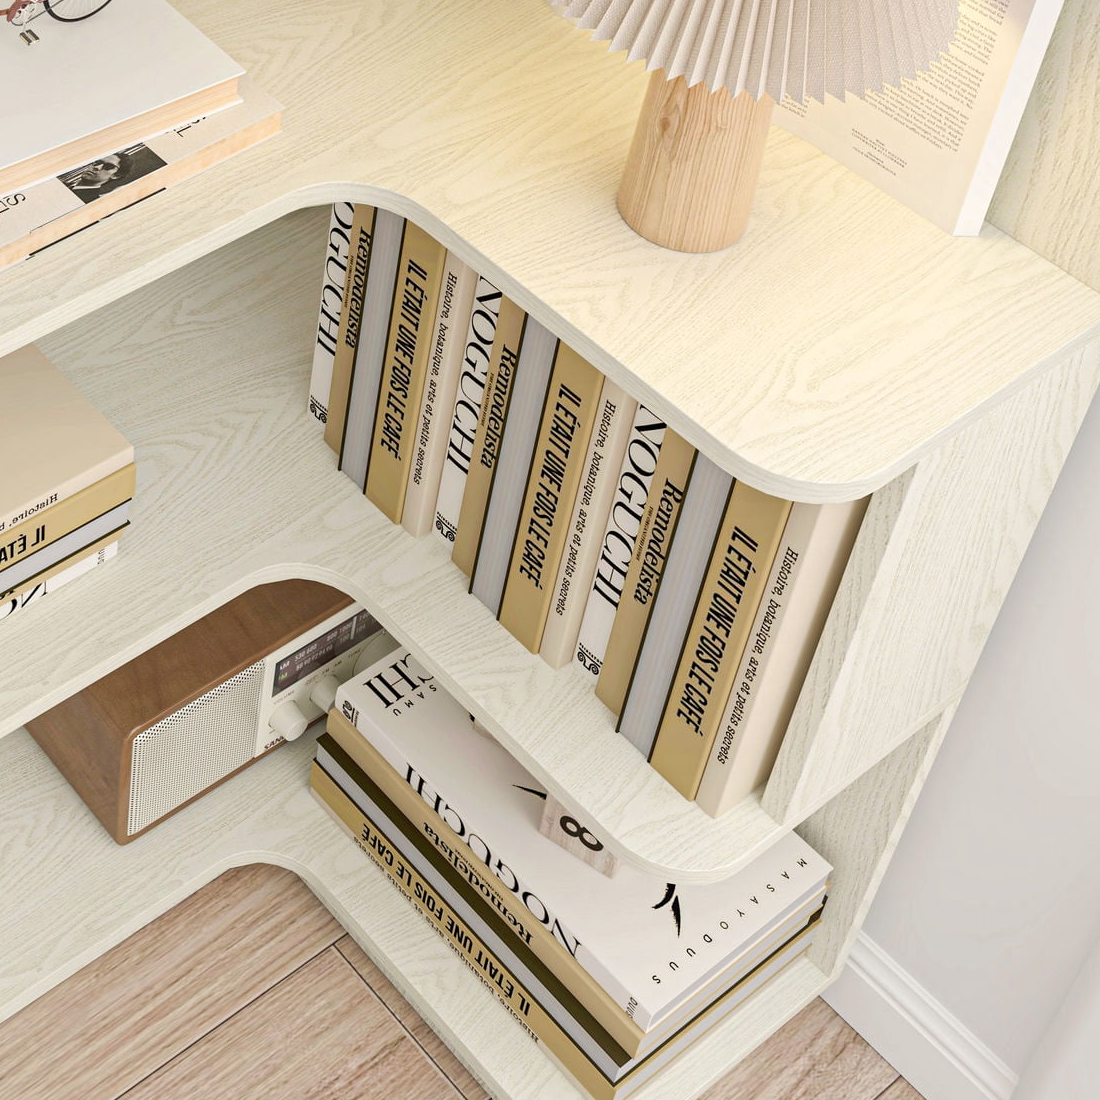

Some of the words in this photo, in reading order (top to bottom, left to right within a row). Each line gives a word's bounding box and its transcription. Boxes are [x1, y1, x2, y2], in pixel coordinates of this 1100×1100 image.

[345, 226, 372, 349] Remodelista
[593, 403, 667, 611] NOGUCHI
[633, 477, 687, 604] Remodelista
[731, 525, 758, 552] IL
[717, 544, 756, 603] ÉTAIT
[771, 546, 798, 595] Histoire,
[705, 592, 737, 638] UNE
[752, 598, 780, 654] botanique,
[695, 625, 726, 671] FOIS
[744, 656, 758, 682] arts
[688, 661, 714, 694] LE
[740, 681, 750, 694] et
[676, 682, 707, 736] CAFÉ
[729, 692, 746, 726] petits
[716, 724, 735, 764] secrets
[559, 813, 605, 853] 8
[405, 763, 581, 958] NOGUCHI
[423, 822, 532, 945] Remodelista
